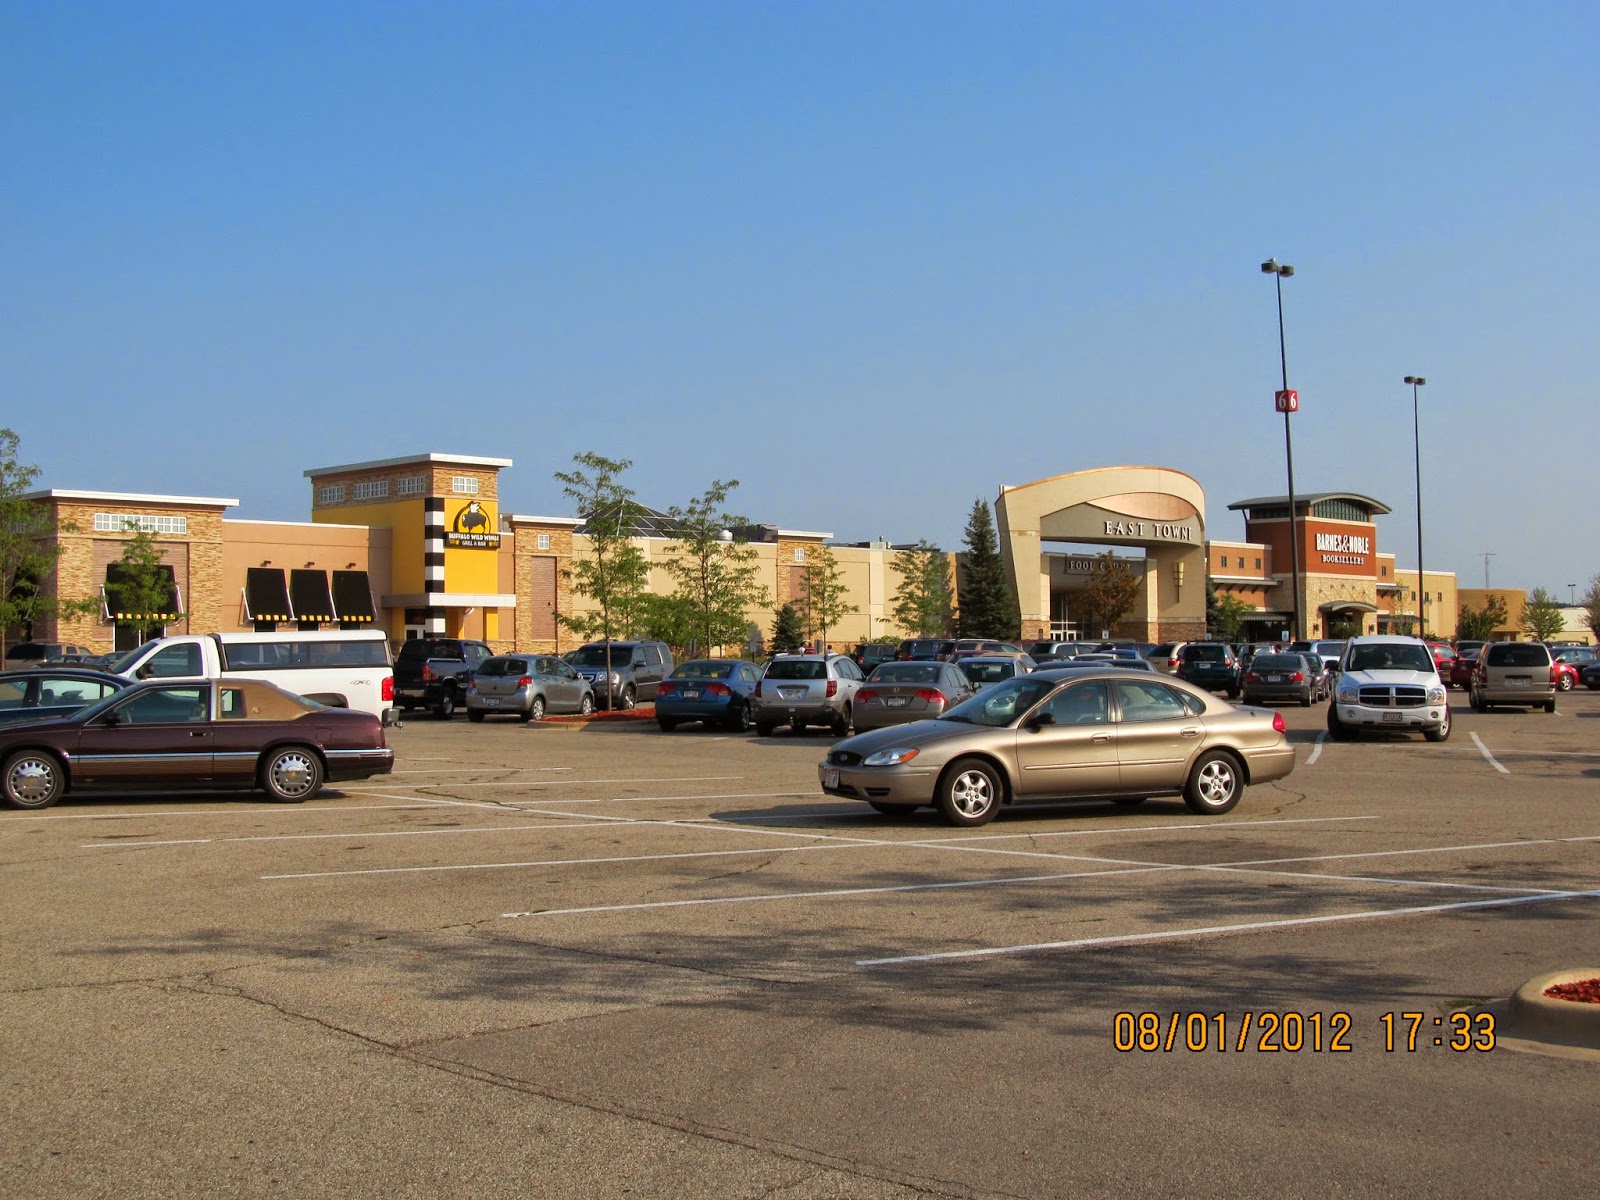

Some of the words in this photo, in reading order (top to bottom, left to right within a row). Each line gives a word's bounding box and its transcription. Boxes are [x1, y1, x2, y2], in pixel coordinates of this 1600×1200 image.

[1278, 392, 1287, 409] 6
[1290, 392, 1297, 409] 6
[471, 533, 484, 541] WILD
[484, 534, 500, 542] WINGS
[1105, 520, 1145, 536] EAST
[1154, 523, 1192, 540] TOWNE
[1322, 554, 1365, 565] BOOKSELLERS
